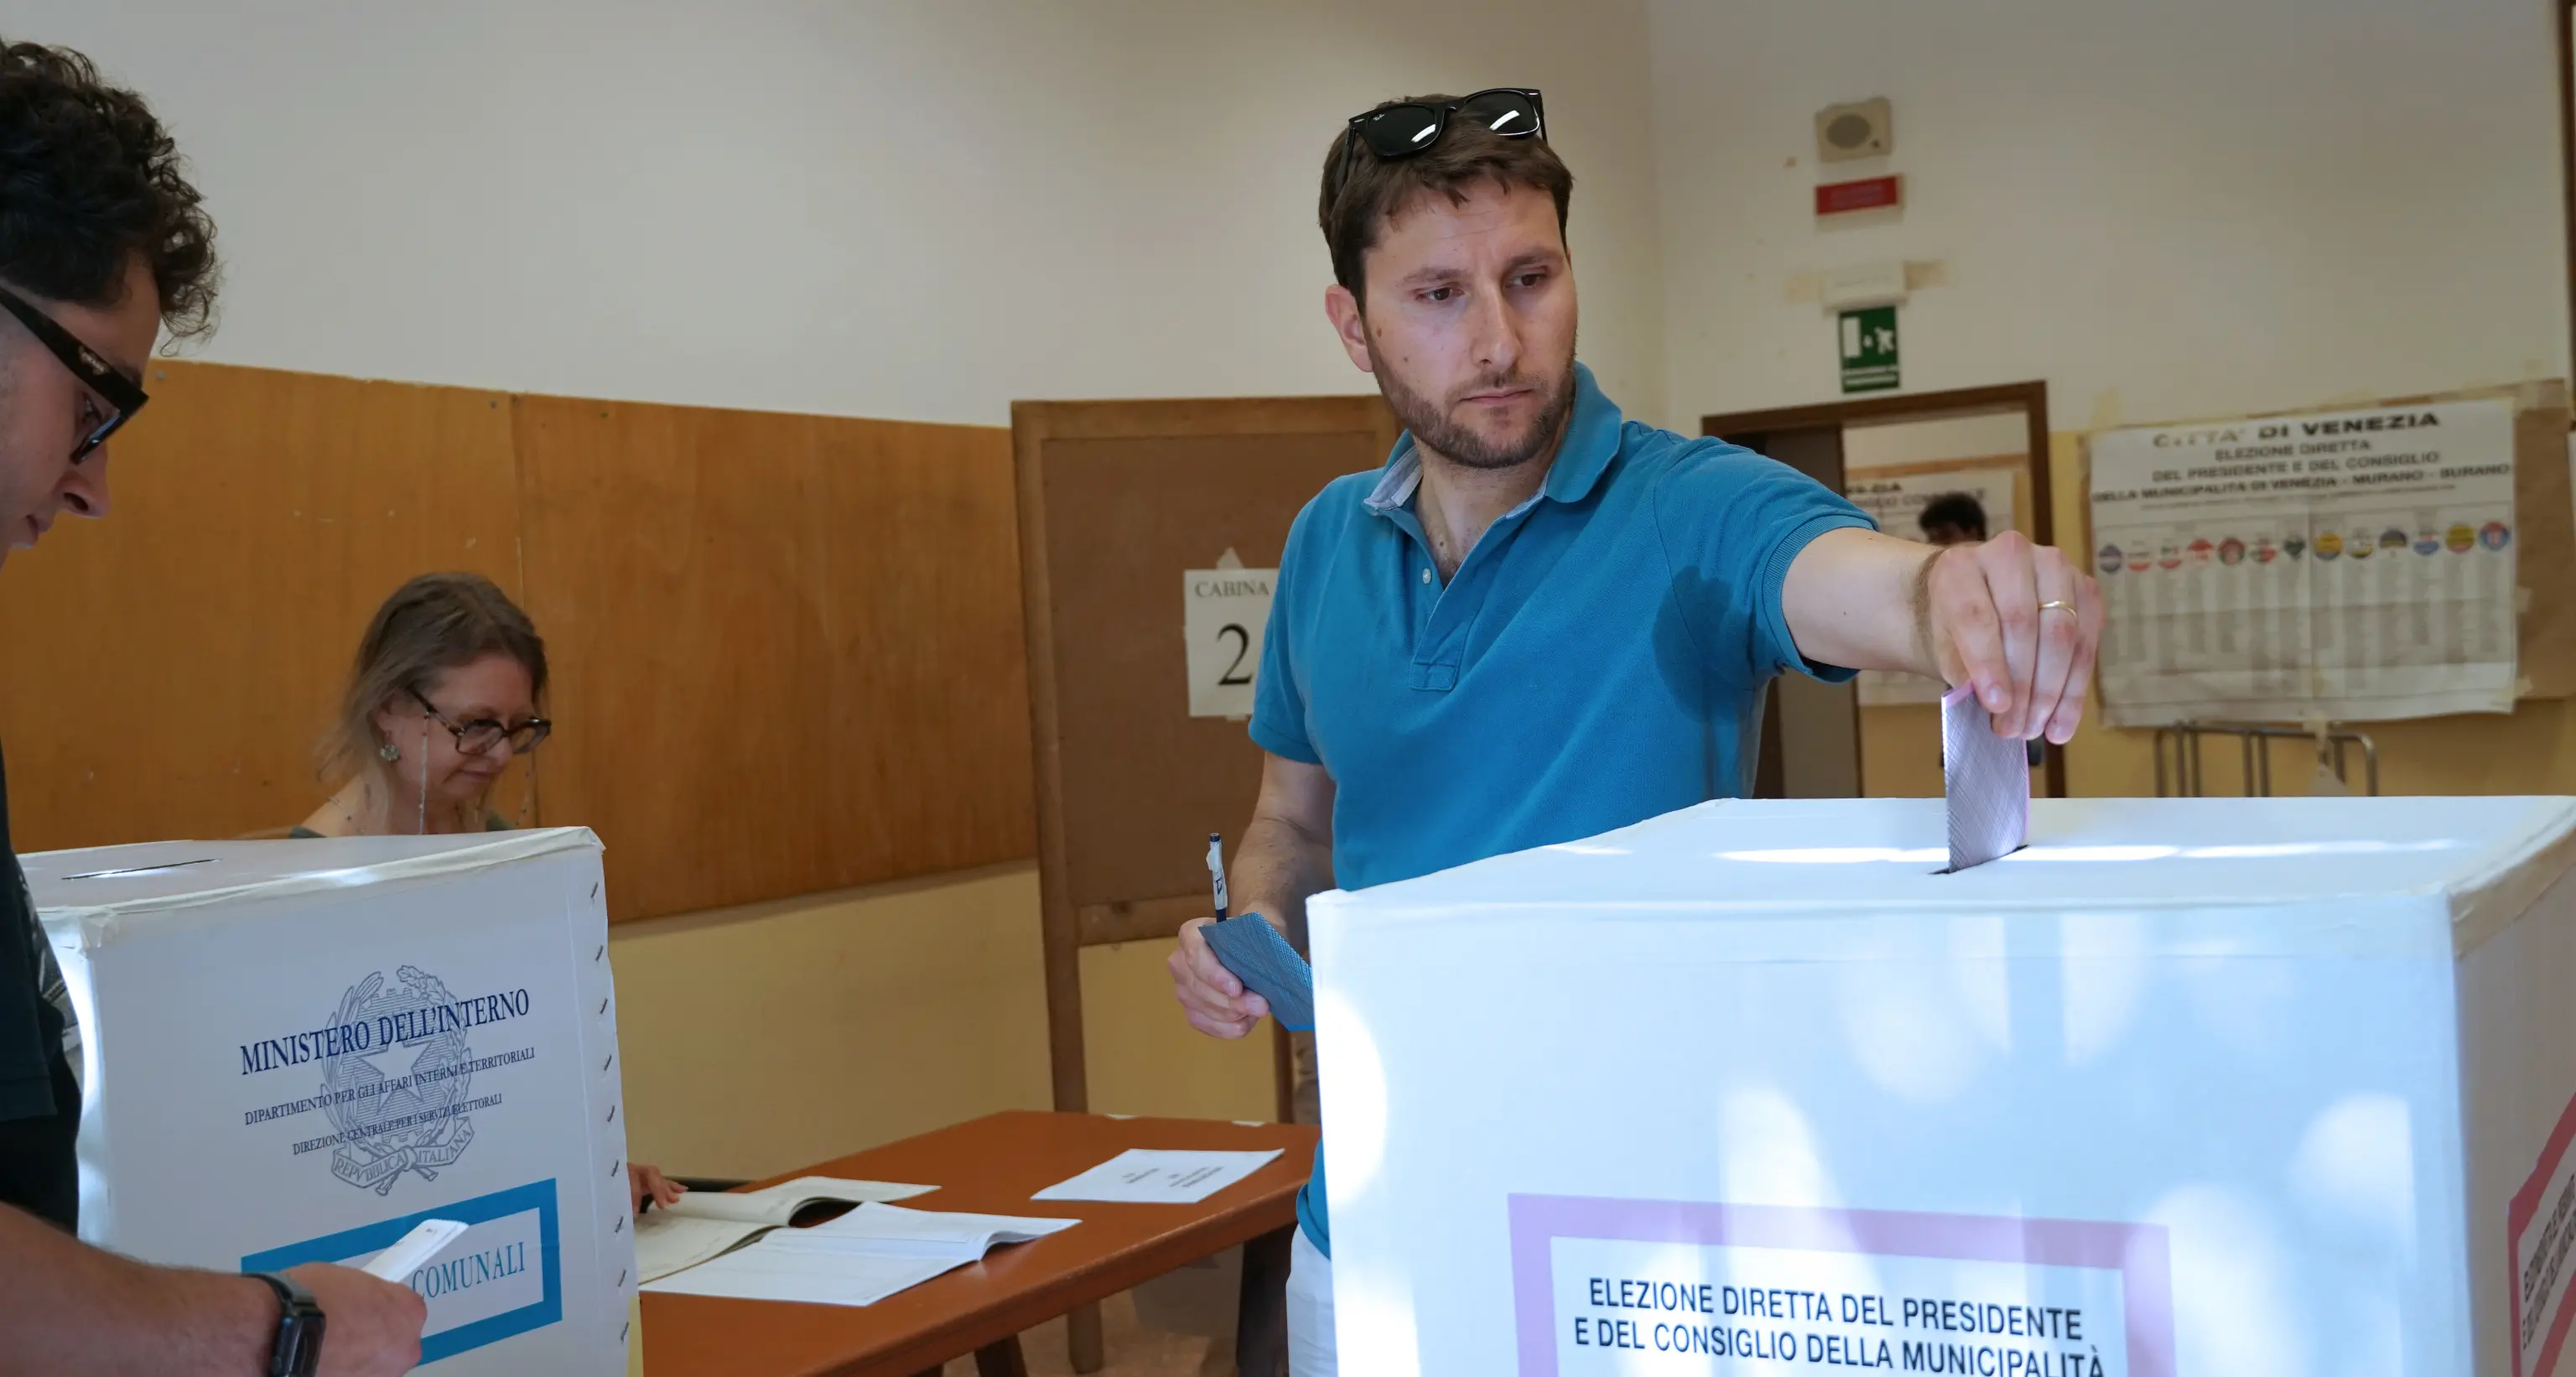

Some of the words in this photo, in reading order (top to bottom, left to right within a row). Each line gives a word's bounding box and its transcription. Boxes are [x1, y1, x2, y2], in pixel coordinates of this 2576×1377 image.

[2215, 444, 2293, 462] ELEZIONE
[2299, 439, 2371, 456] DIRETTA
[2258, 424, 2289, 439] DI
[2301, 412, 2439, 436] VENEZIA
[2152, 470, 2181, 482] DEL
[2188, 461, 2288, 480] PRESIDENTE
[2293, 462, 2303, 473] E
[2309, 459, 2340, 472] DEL
[2345, 451, 2440, 470] CONSIGLIO
[2271, 476, 2337, 490] VENEZIA
[2352, 469, 2424, 486] MURANO
[2439, 463, 2511, 480] BURANO
[1194, 579, 1270, 598] CABINA
[1217, 623, 1253, 686] 2
[240, 1021, 371, 1075] MINISTERO
[378, 988, 530, 1047] DELL'INTERNO
[244, 1094, 332, 1125] DIPARTIMENTO
[335, 1089, 356, 1104] PER
[358, 1085, 376, 1099] GLI
[376, 1074, 413, 1094] AFFARI
[415, 1064, 457, 1086] INTERNI
[460, 1063, 467, 1075] E
[469, 1047, 535, 1073] TERRITORIALI
[293, 1132, 346, 1156] DIREZIONE
[347, 1120, 394, 1141] CENTRALE
[397, 1116, 412, 1129] PER
[419, 1104, 450, 1124] SERVIZI
[452, 1093, 503, 1116] ELETTORALI
[418, 1130, 471, 1162] ITALIANA
[413, 1241, 526, 1301] COMUNALI
[1590, 1277, 1715, 1314] ELEZIONE
[1722, 1286, 1833, 1323] DIRETTA
[1841, 1293, 1893, 1327] DEL
[1903, 1297, 2083, 1341] PRESIDENTE
[1574, 1317, 1590, 1346] E
[1597, 1318, 1646, 1349] DEL
[1654, 1322, 1797, 1362] CONSIGLIO
[1807, 1333, 1893, 1369] DELLA
[1903, 1340, 2105, 1377] MUNICIPALITÀ
